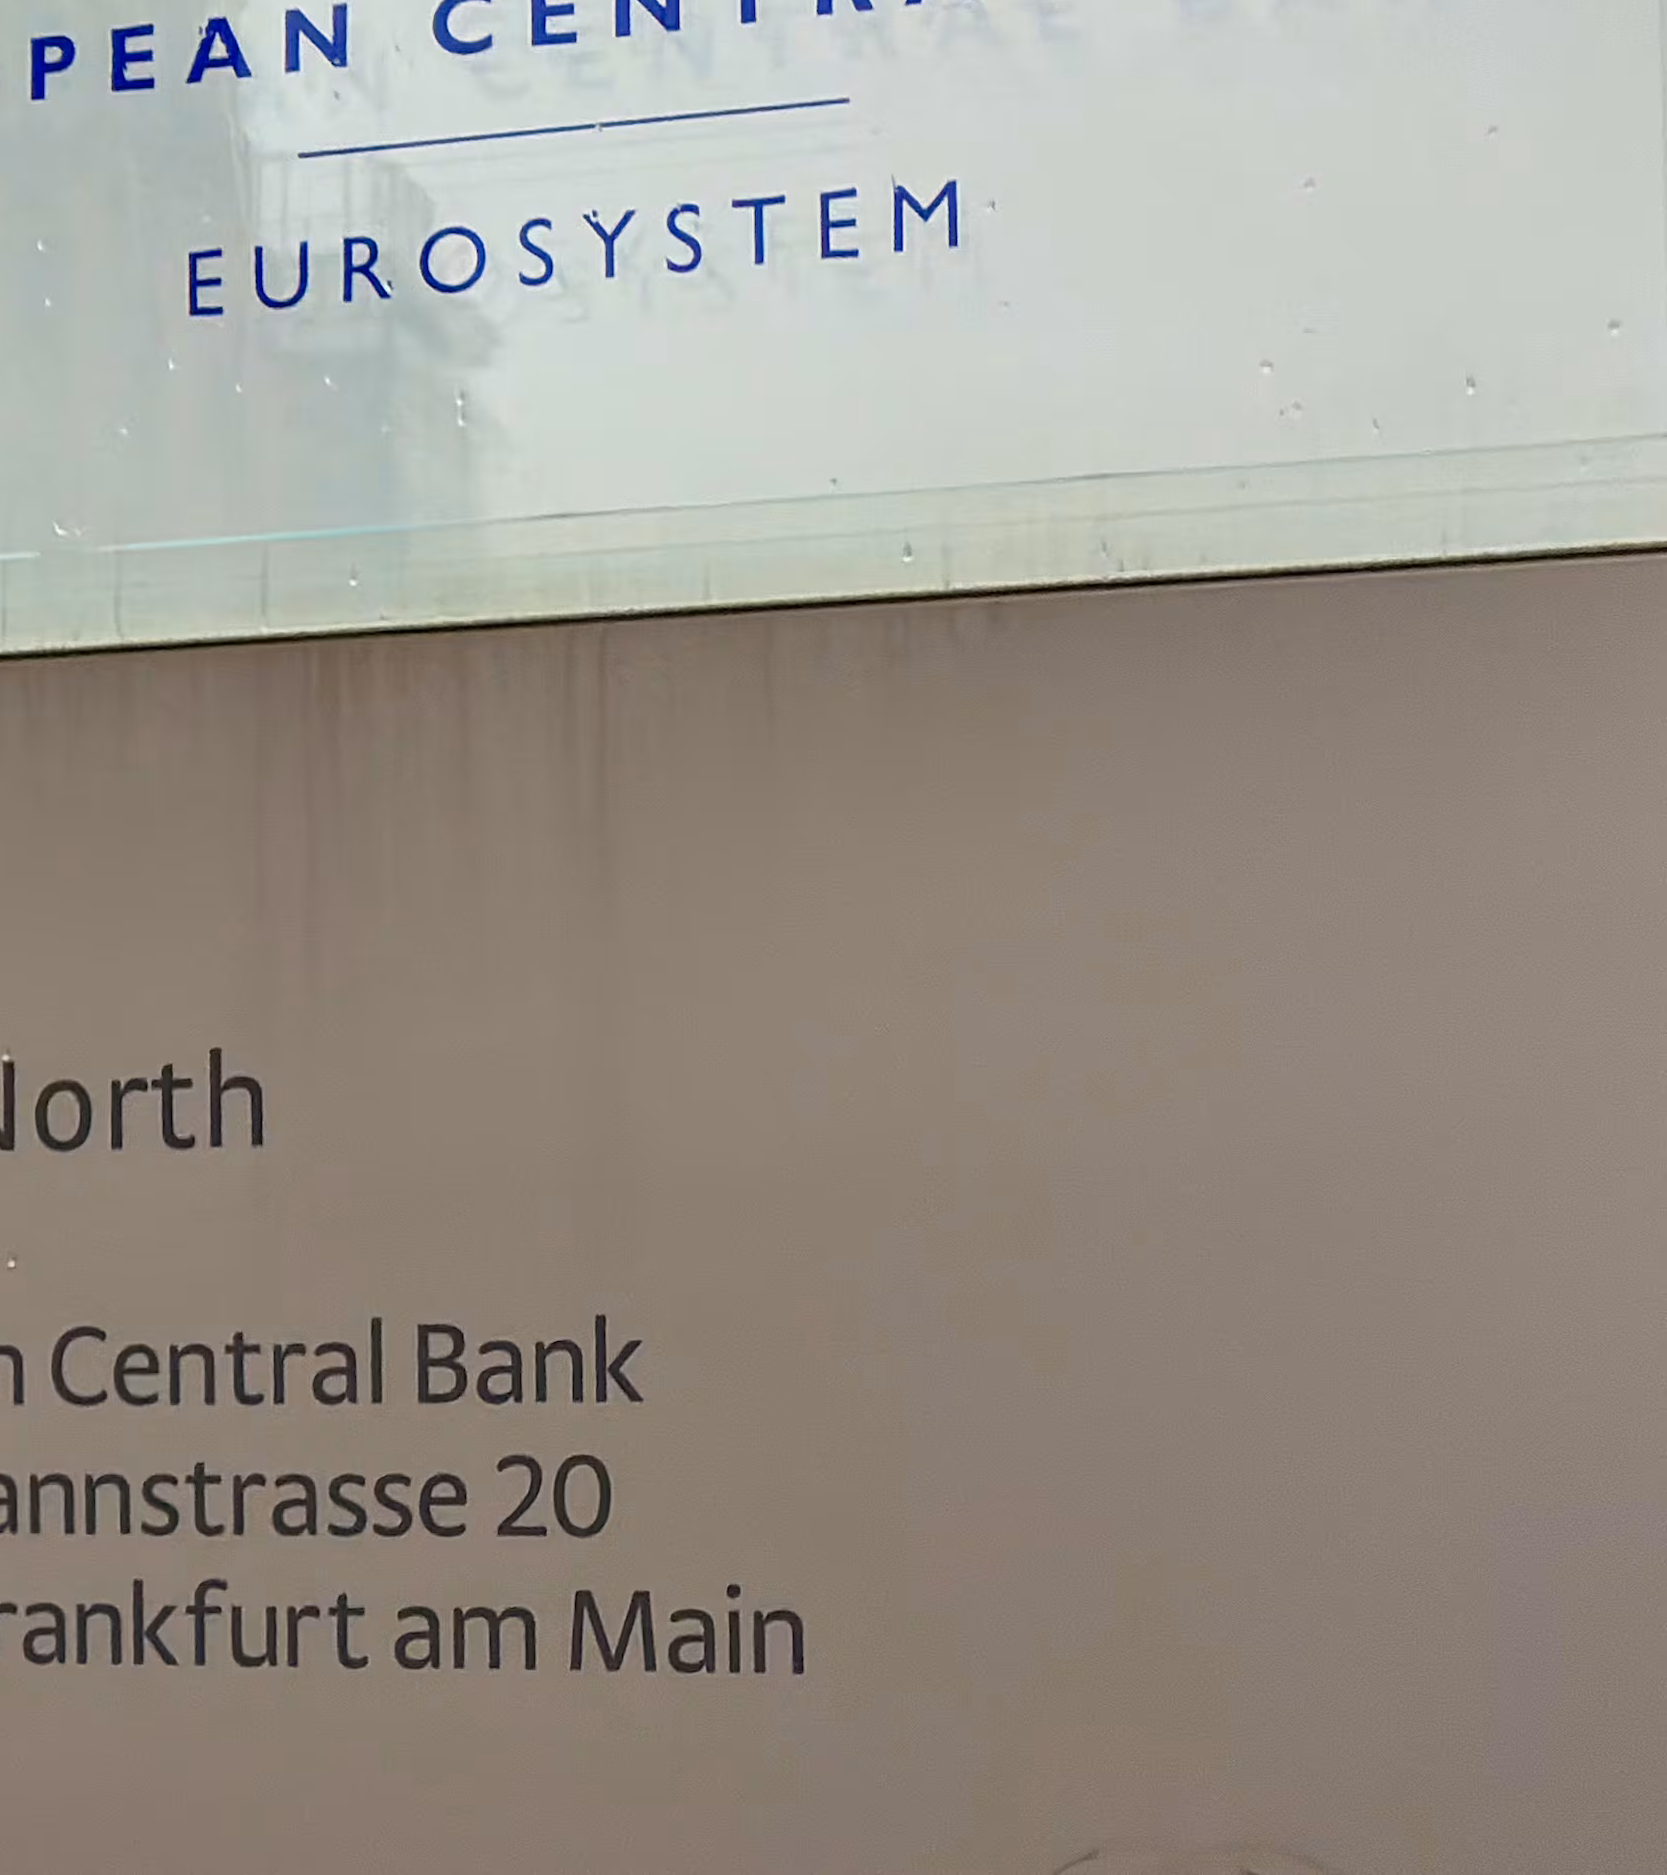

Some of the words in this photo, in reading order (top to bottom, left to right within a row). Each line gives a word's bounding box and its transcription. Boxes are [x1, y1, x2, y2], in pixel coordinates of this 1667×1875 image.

[187, 179, 959, 317] EUROSYSTEM
[50, 1315, 384, 1407] Central
[416, 1312, 645, 1406] Bank
[495, 1452, 613, 1540] 20
[393, 1604, 538, 1672] am
[568, 1582, 806, 1676] Main
